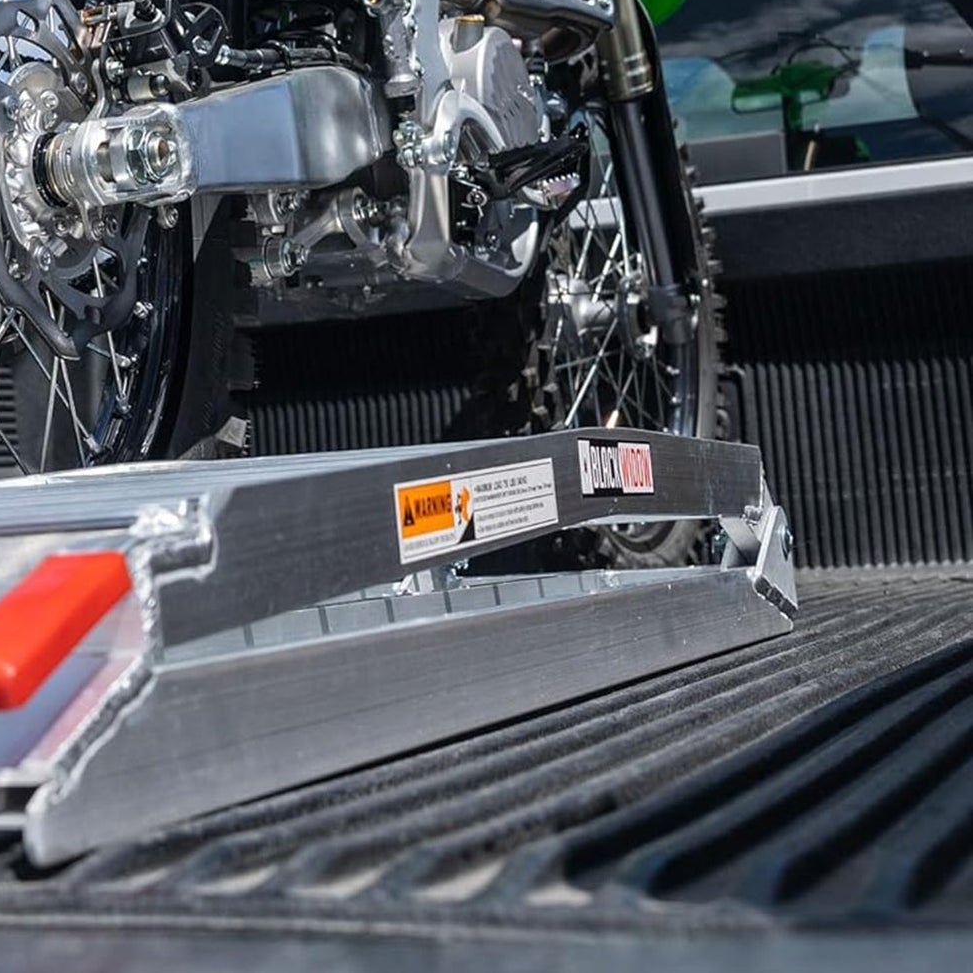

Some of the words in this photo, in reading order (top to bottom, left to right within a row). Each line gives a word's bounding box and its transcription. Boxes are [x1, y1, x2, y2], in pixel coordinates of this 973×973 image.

[590, 446, 622, 489] BLACK
[619, 447, 653, 488] WIDOW
[414, 493, 452, 520] WARNING
